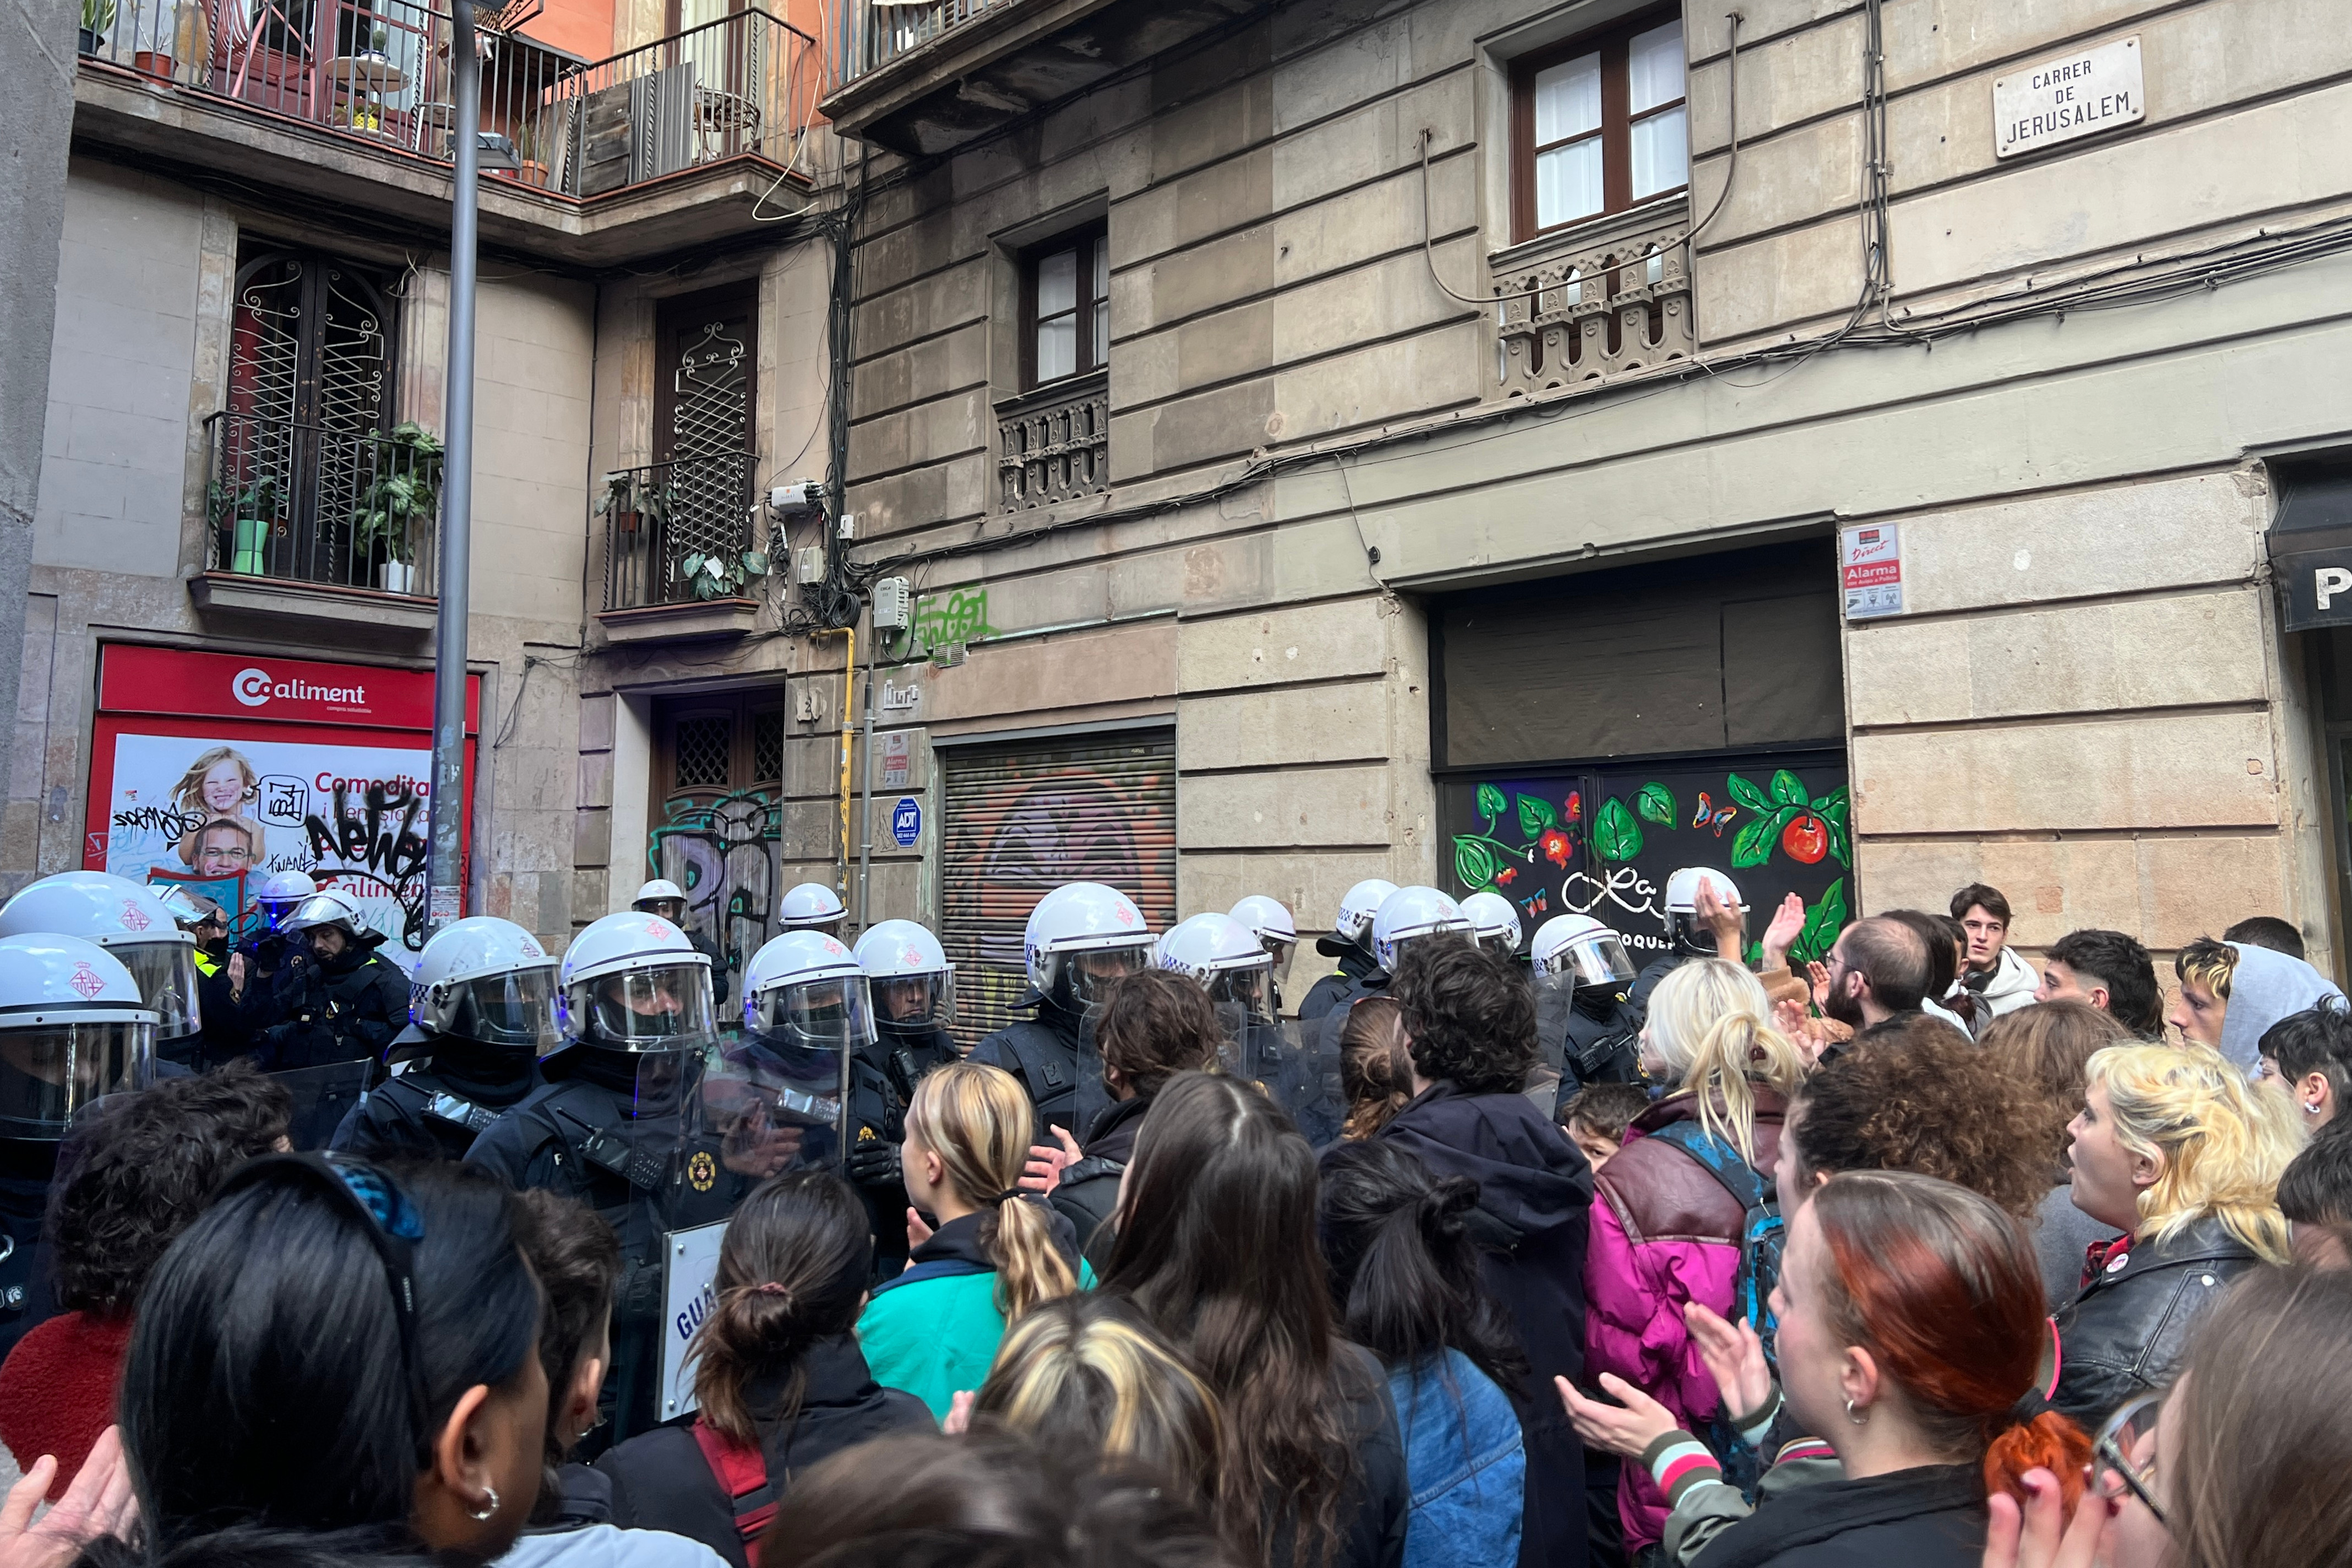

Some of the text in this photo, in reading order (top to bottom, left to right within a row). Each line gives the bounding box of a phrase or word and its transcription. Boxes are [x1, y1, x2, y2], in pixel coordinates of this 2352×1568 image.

[2033, 60, 2092, 89] CARRER
[2056, 86, 2075, 104] DE
[2007, 91, 2130, 143] JERUSALEM
[1852, 540, 1891, 561] Direct
[1847, 565, 1897, 580] Alarma
[2315, 567, 2352, 610] P
[315, 772, 430, 797] Comodita
[897, 812, 917, 829] ADT
[677, 1289, 717, 1340] GUA
